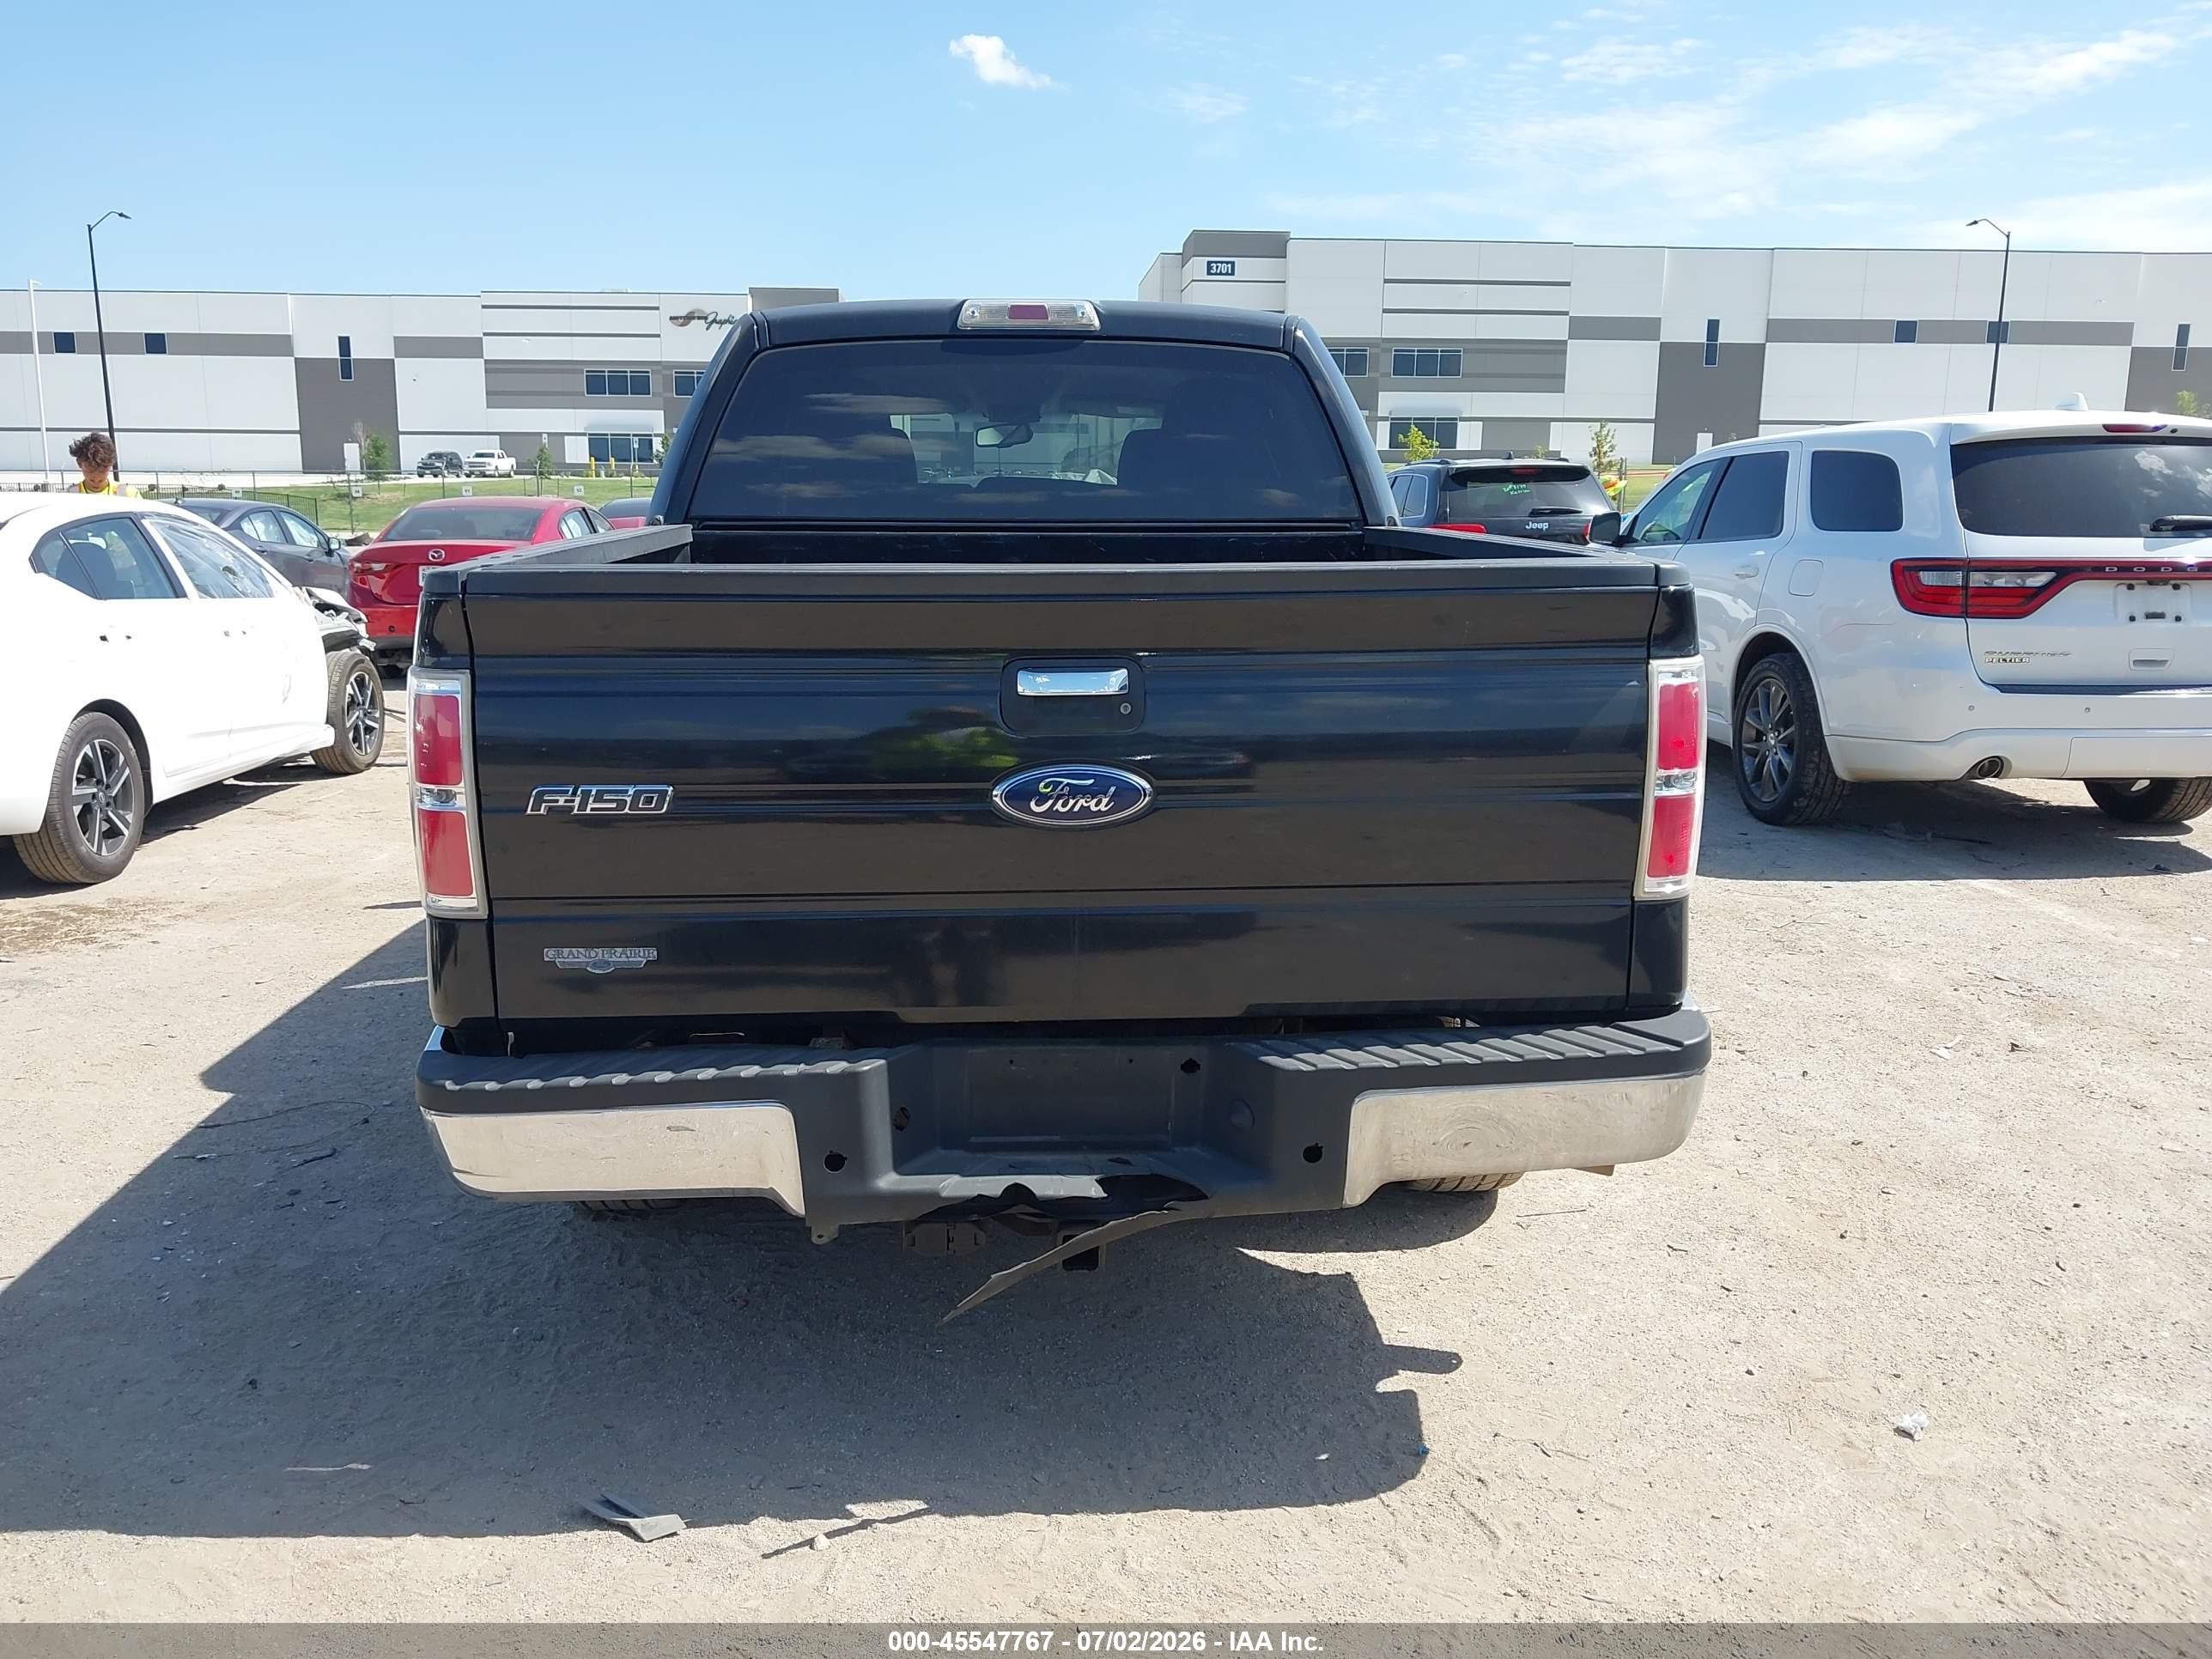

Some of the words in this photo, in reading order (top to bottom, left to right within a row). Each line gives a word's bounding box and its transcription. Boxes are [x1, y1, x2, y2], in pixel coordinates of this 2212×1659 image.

[1210, 263, 1232, 274] 3701
[1525, 520, 1549, 531] Jeep
[526, 784, 674, 815] F-150
[1030, 777, 1117, 813] Ford
[545, 949, 599, 959] GRAND
[600, 949, 655, 959] PRAIRIE
